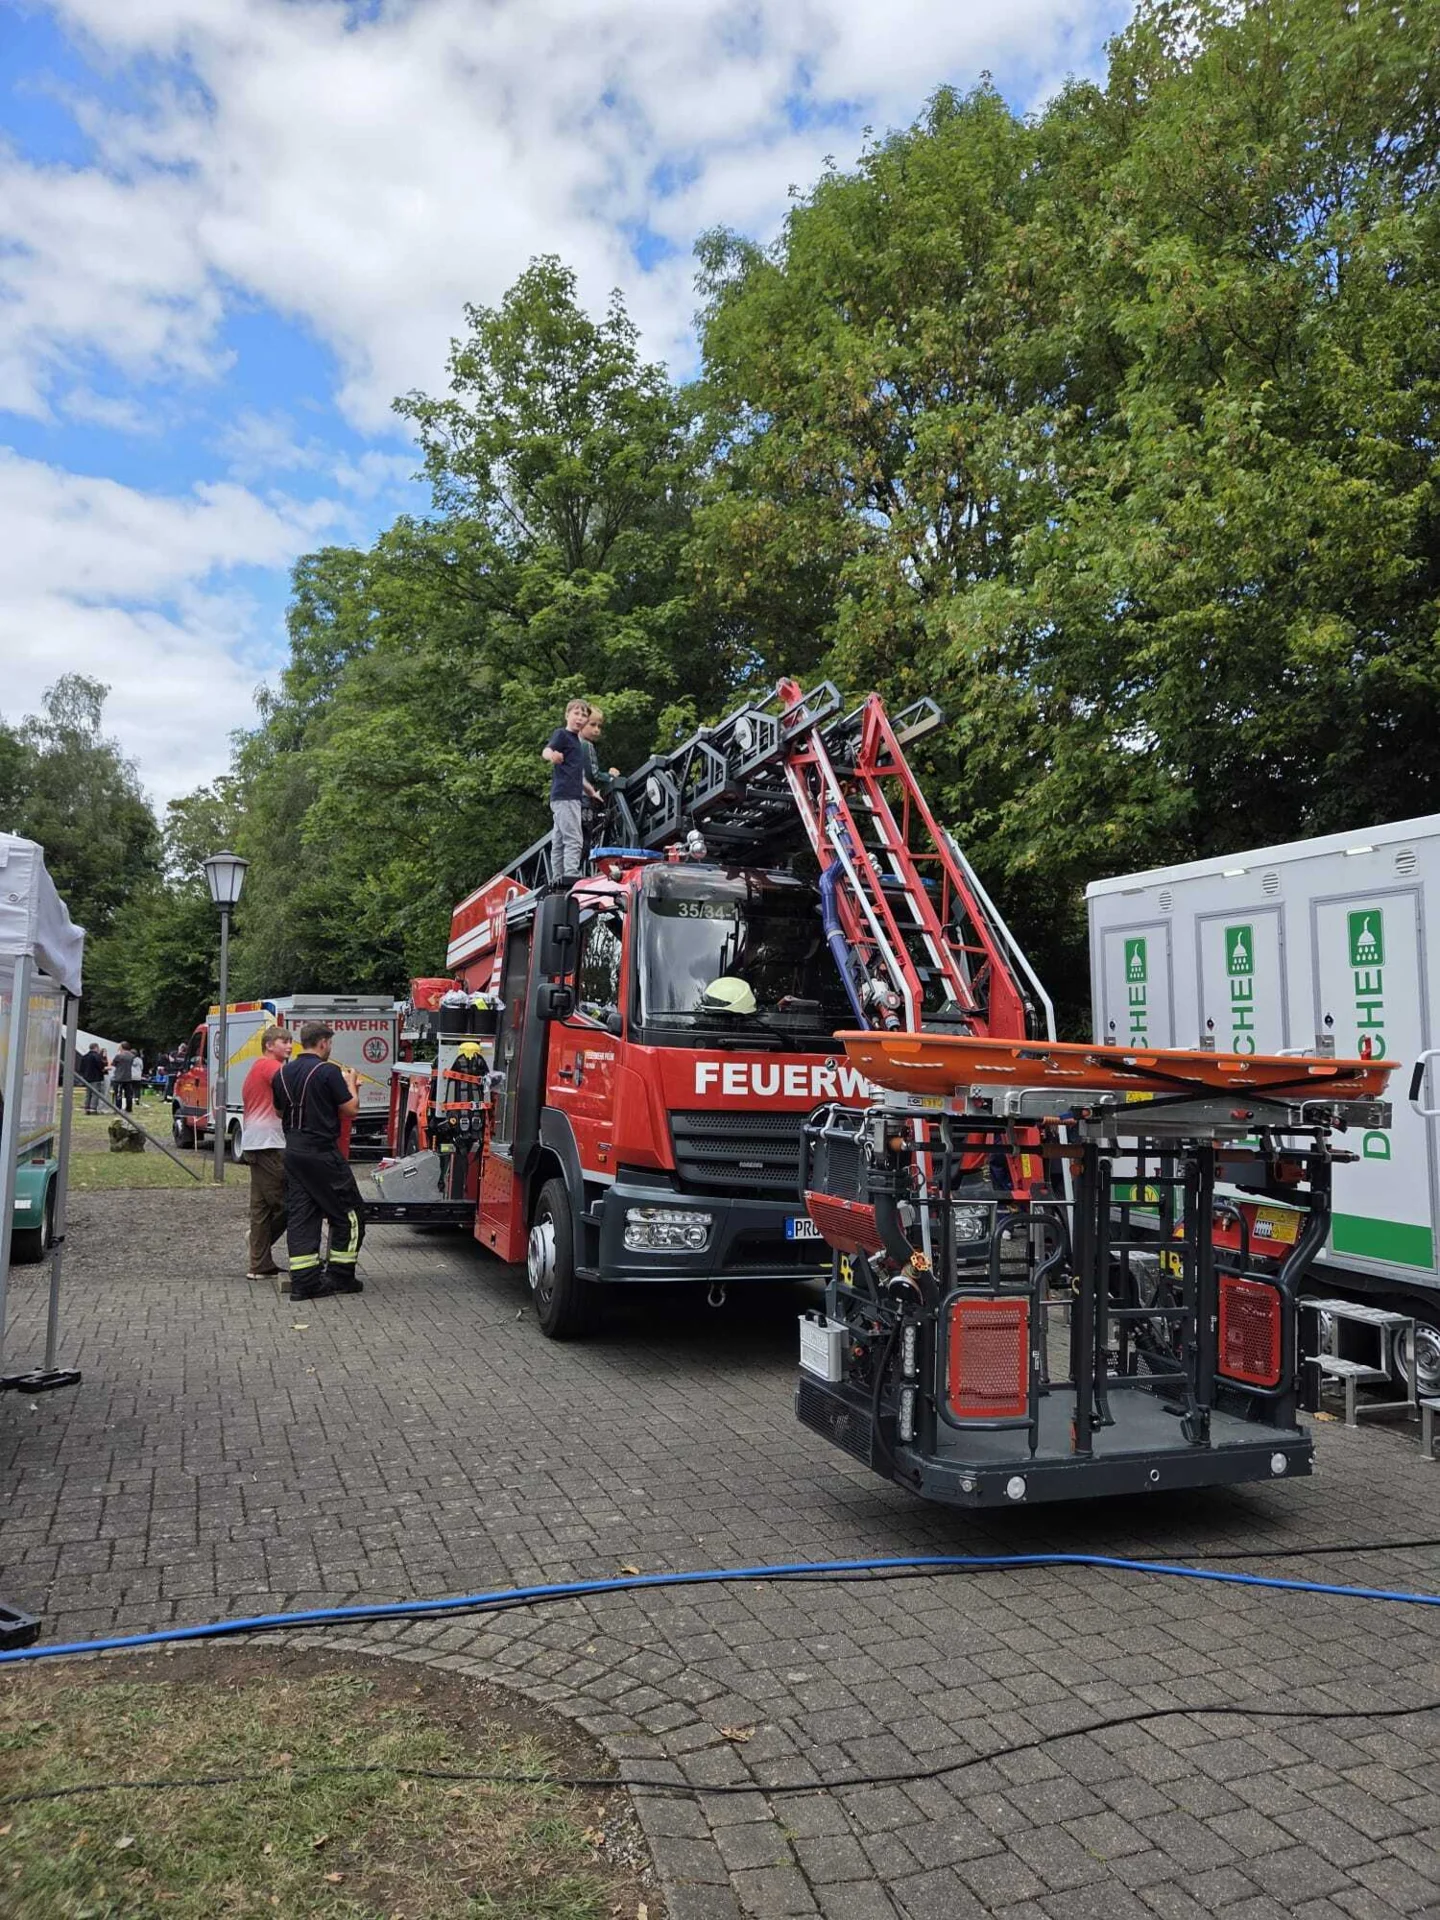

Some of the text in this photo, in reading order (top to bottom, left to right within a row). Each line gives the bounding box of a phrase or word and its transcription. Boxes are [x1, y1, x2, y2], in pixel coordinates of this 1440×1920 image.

[678, 902, 739, 920] 35/34-1
[292, 1020, 389, 1031] FERWEHR
[1129, 985, 1148, 1049] CHE
[695, 1062, 870, 1098] FEUERW
[1354, 969, 1391, 1160] DCHE
